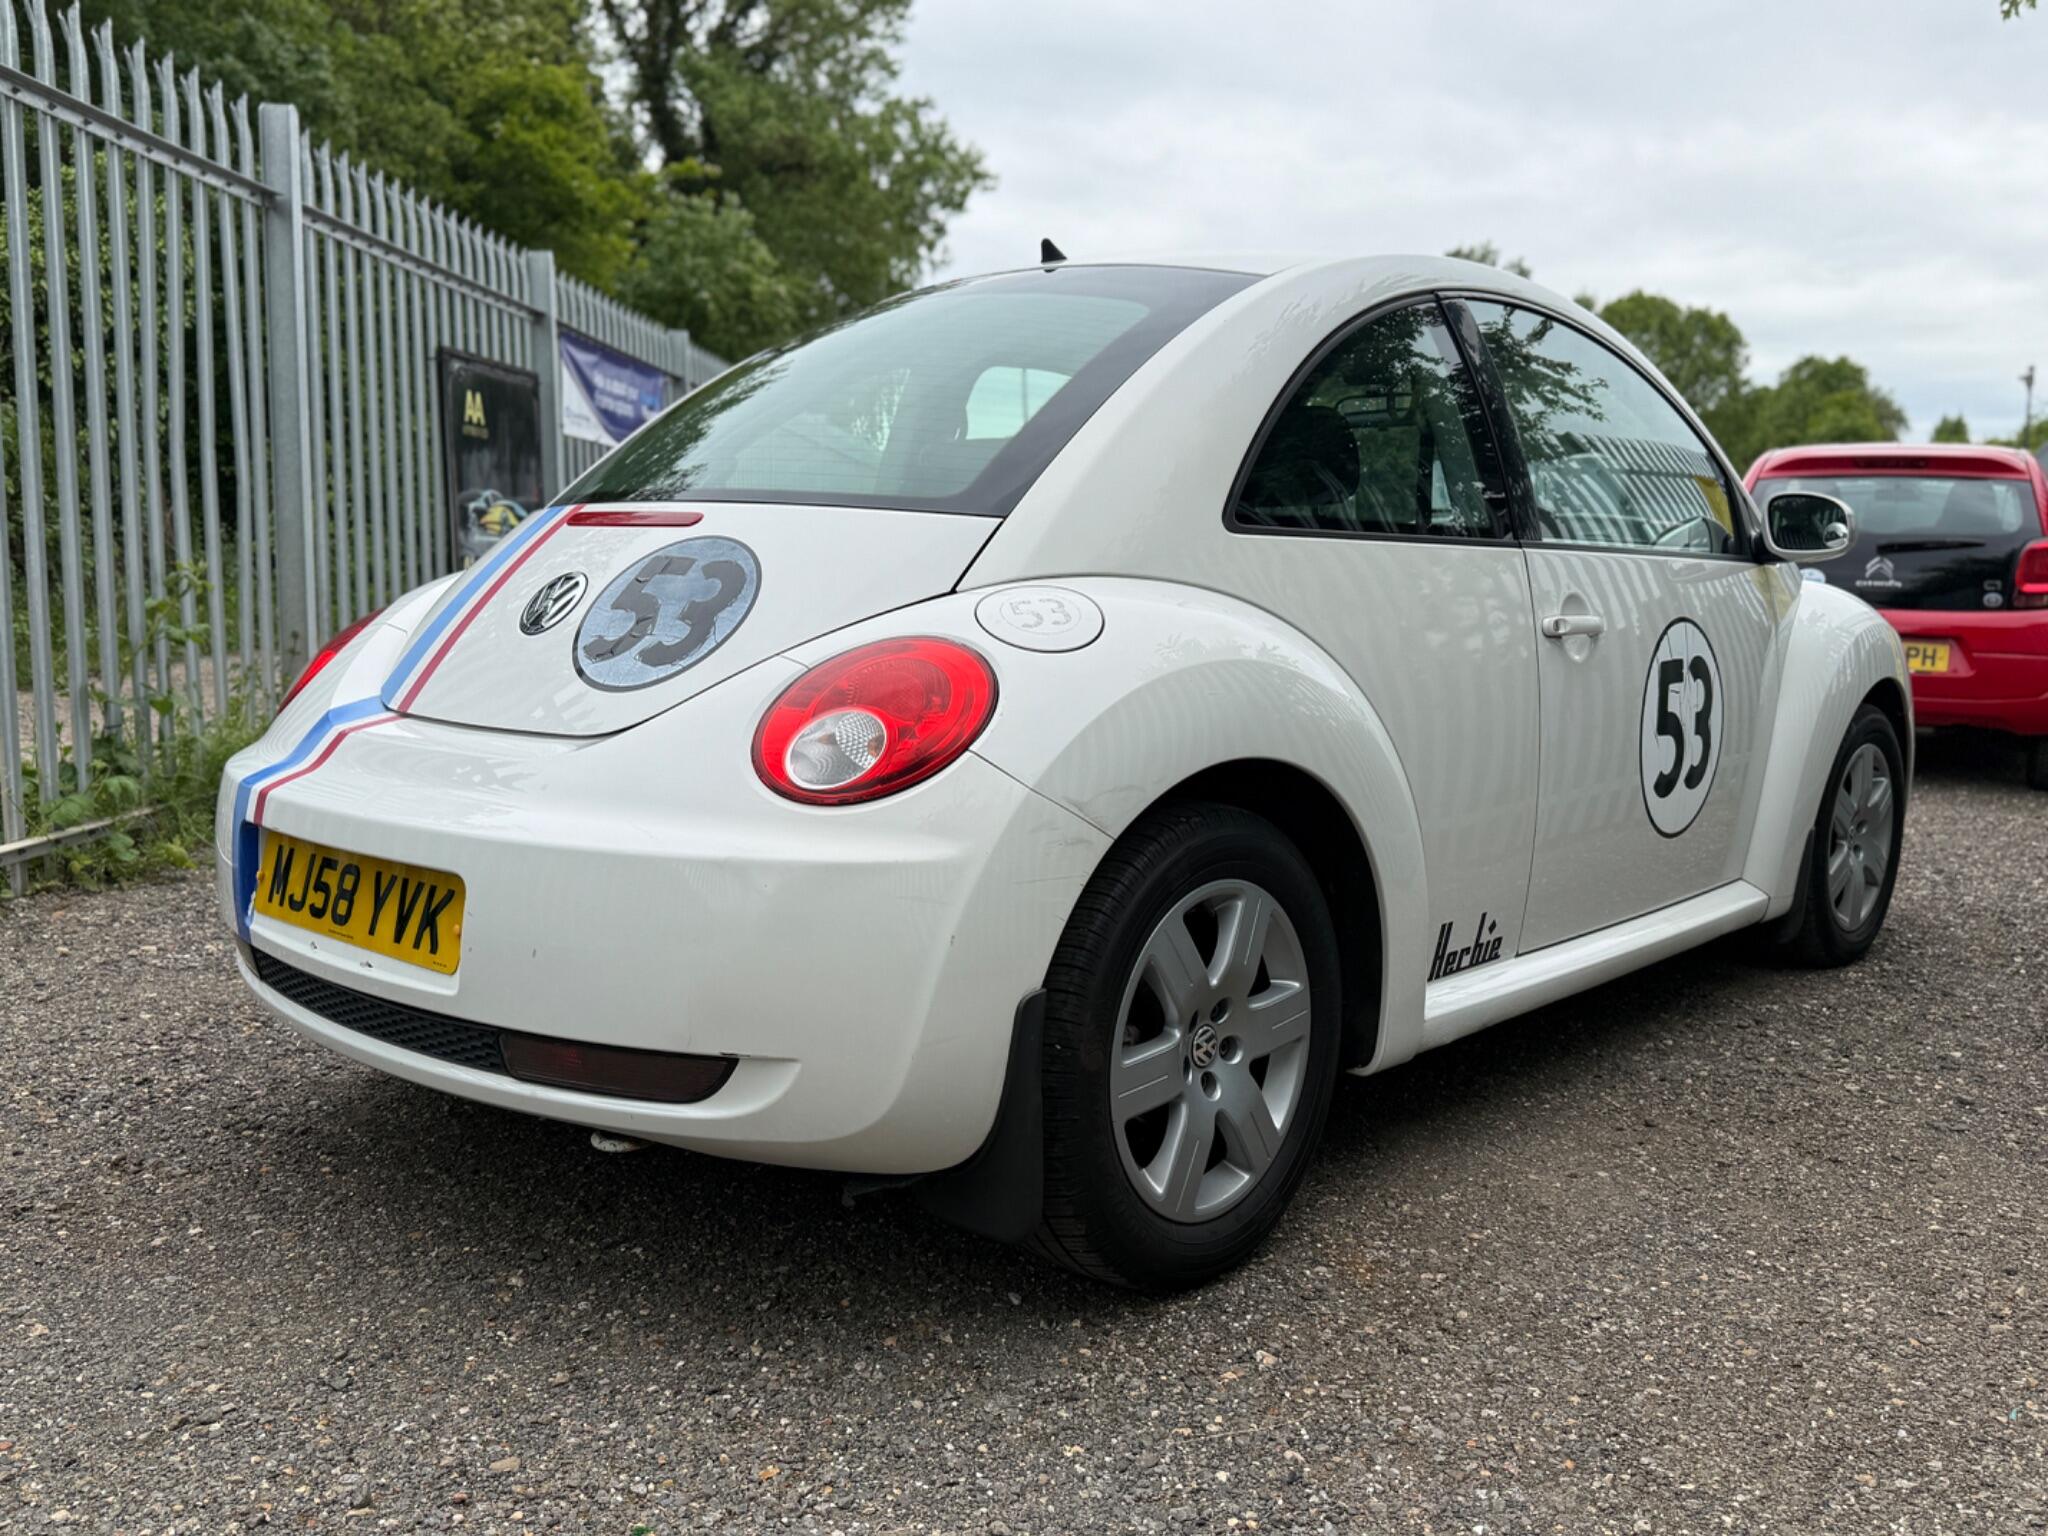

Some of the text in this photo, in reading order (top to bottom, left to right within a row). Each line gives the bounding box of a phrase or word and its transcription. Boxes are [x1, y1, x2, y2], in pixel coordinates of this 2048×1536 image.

[464, 389, 486, 426] AA
[583, 555, 747, 667] 53
[1009, 598, 1072, 629] 53
[1653, 655, 1713, 798] 53
[267, 844, 456, 955] MJ58 YVK
[1427, 912, 1503, 982] Herbie
